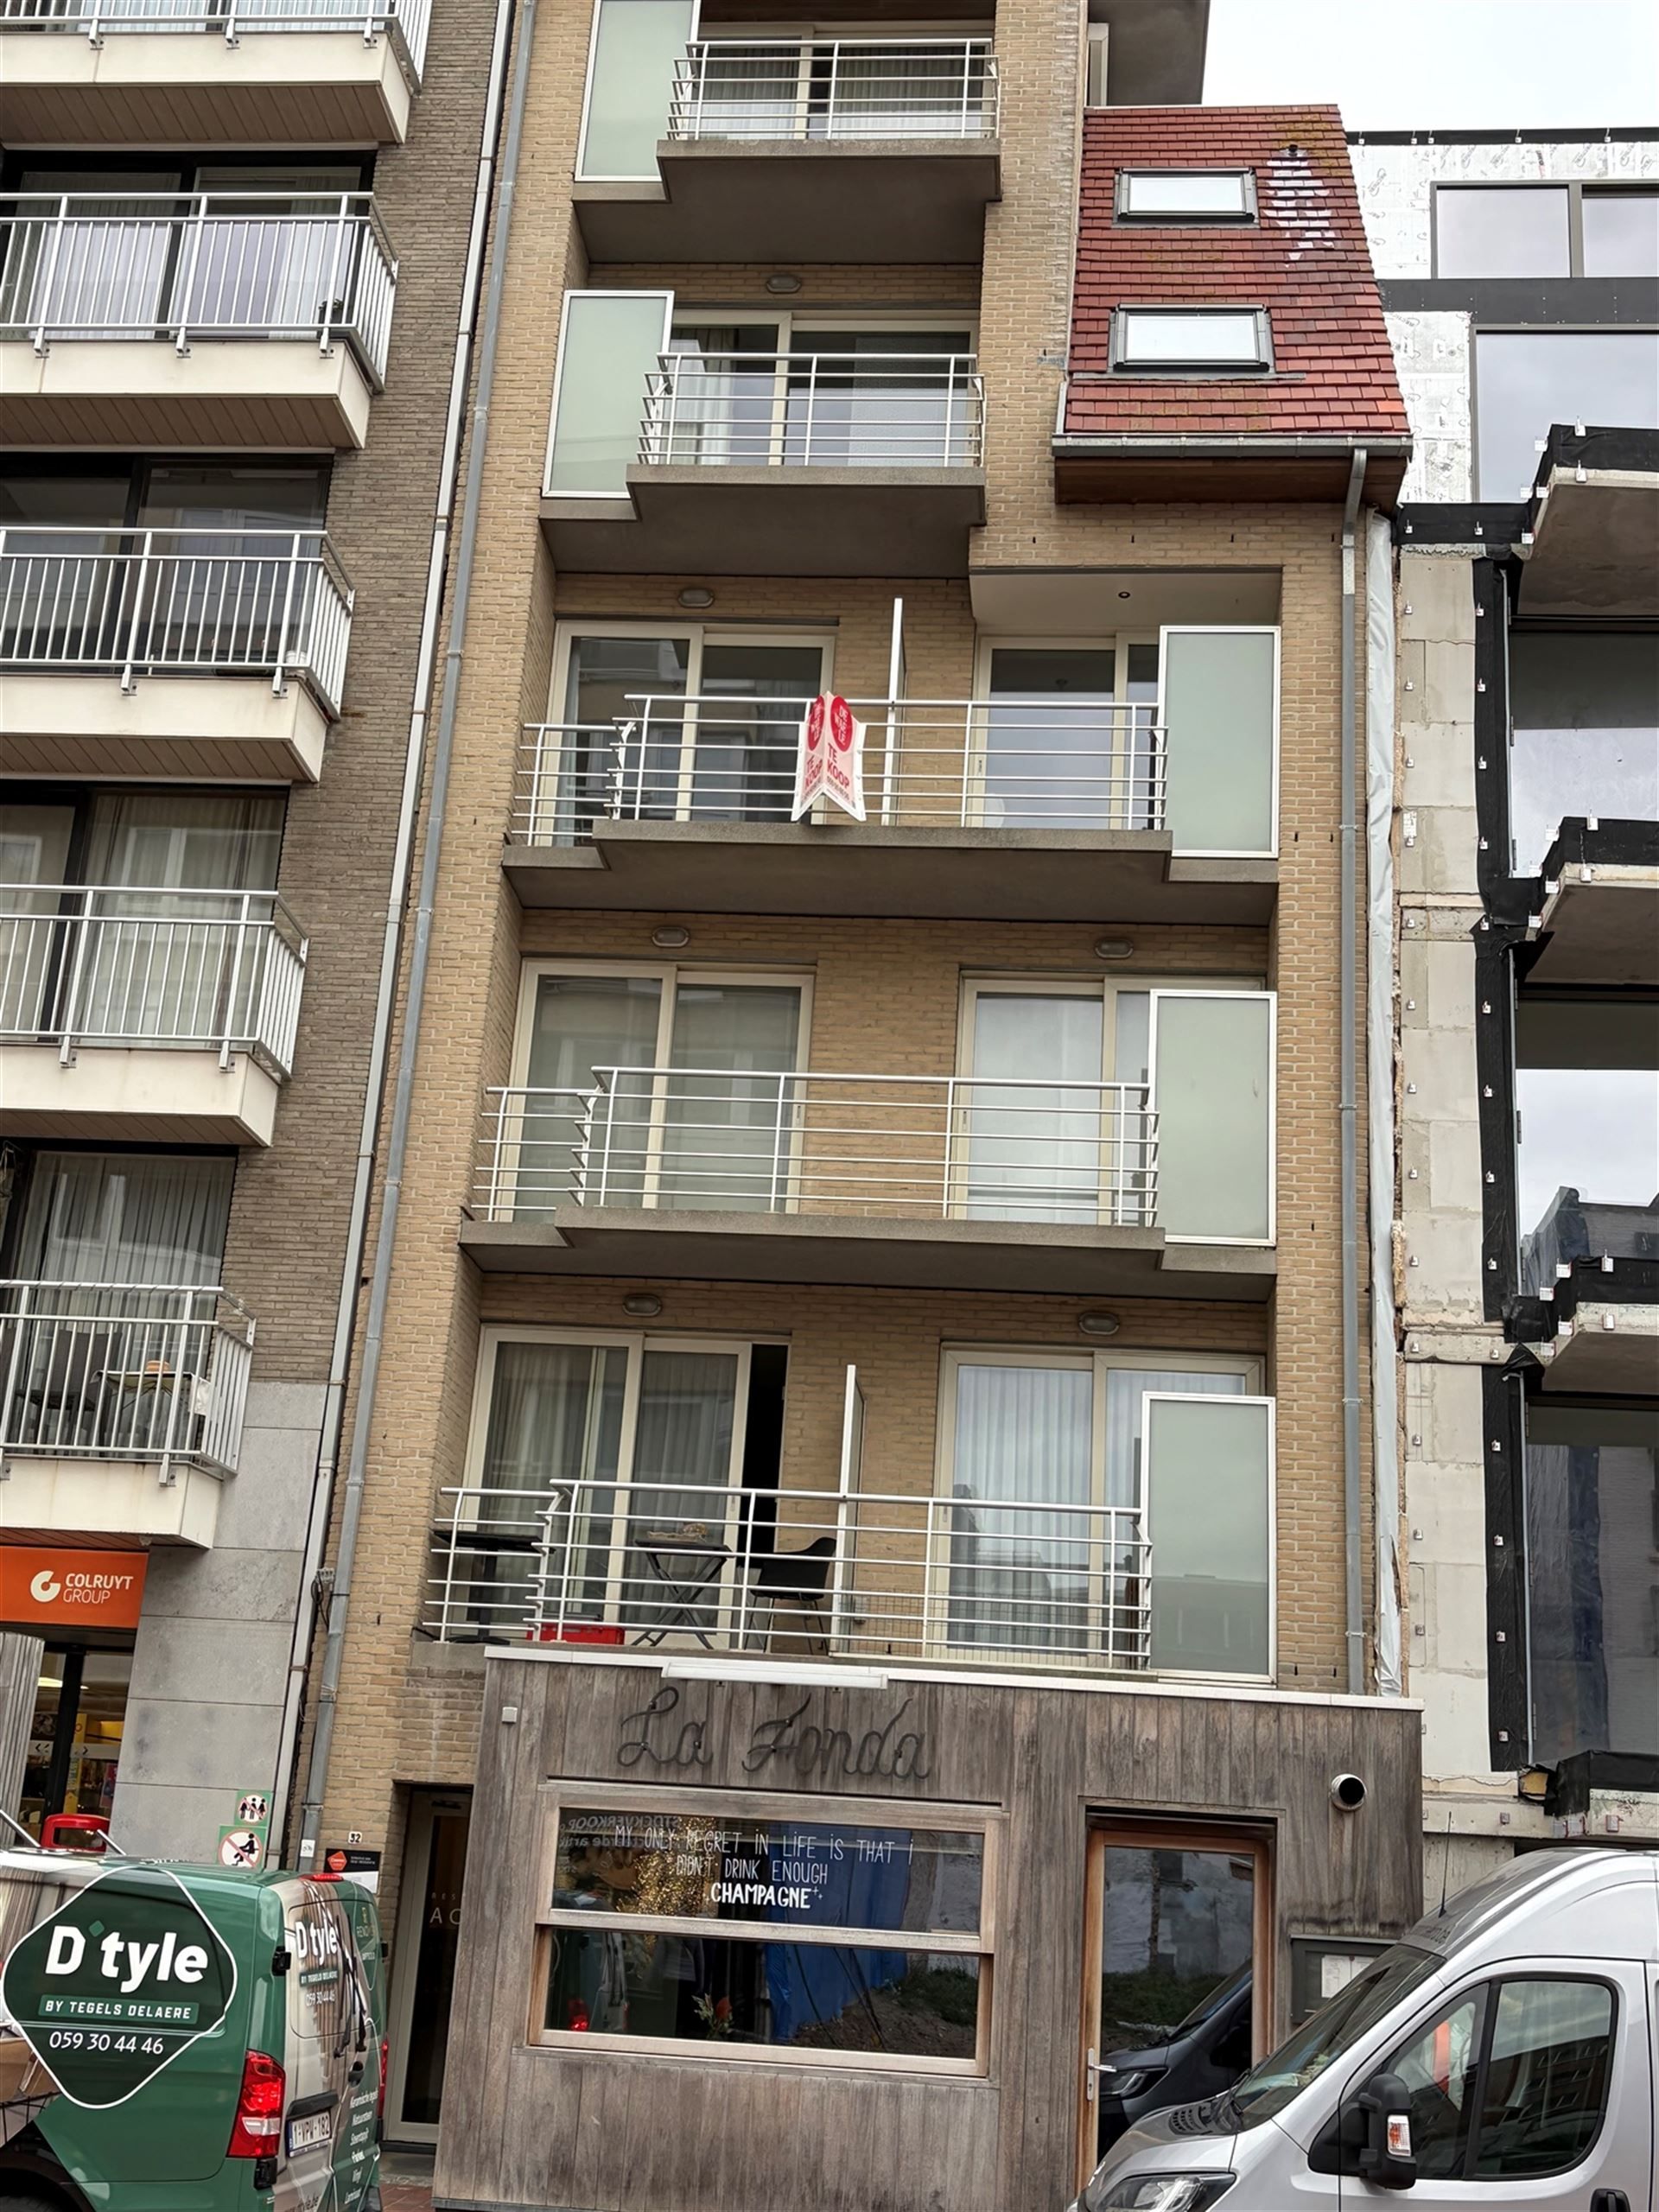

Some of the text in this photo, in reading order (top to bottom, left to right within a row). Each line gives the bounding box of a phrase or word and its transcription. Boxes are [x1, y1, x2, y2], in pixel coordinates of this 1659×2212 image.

[828, 742, 837, 764] TE
[827, 760, 850, 790] KOOP
[66, 1573, 134, 1590] COLRUYT
[63, 1588, 111, 1605] GROUP
[616, 1685, 932, 1781] La Fonda
[614, 1825, 633, 1847] MY
[645, 1827, 676, 1851] ONLY
[686, 1829, 742, 1853] REGRET
[856, 1839, 895, 1864] THAT
[725, 1858, 760, 1880] DRINK
[772, 1859, 829, 1885] ENOUGH
[710, 1882, 811, 1909] CHAMPAGNE
[45, 2000, 192, 2019] BY TEGELS DELAERE
[49, 2031, 164, 2055] 059 30 44 46
